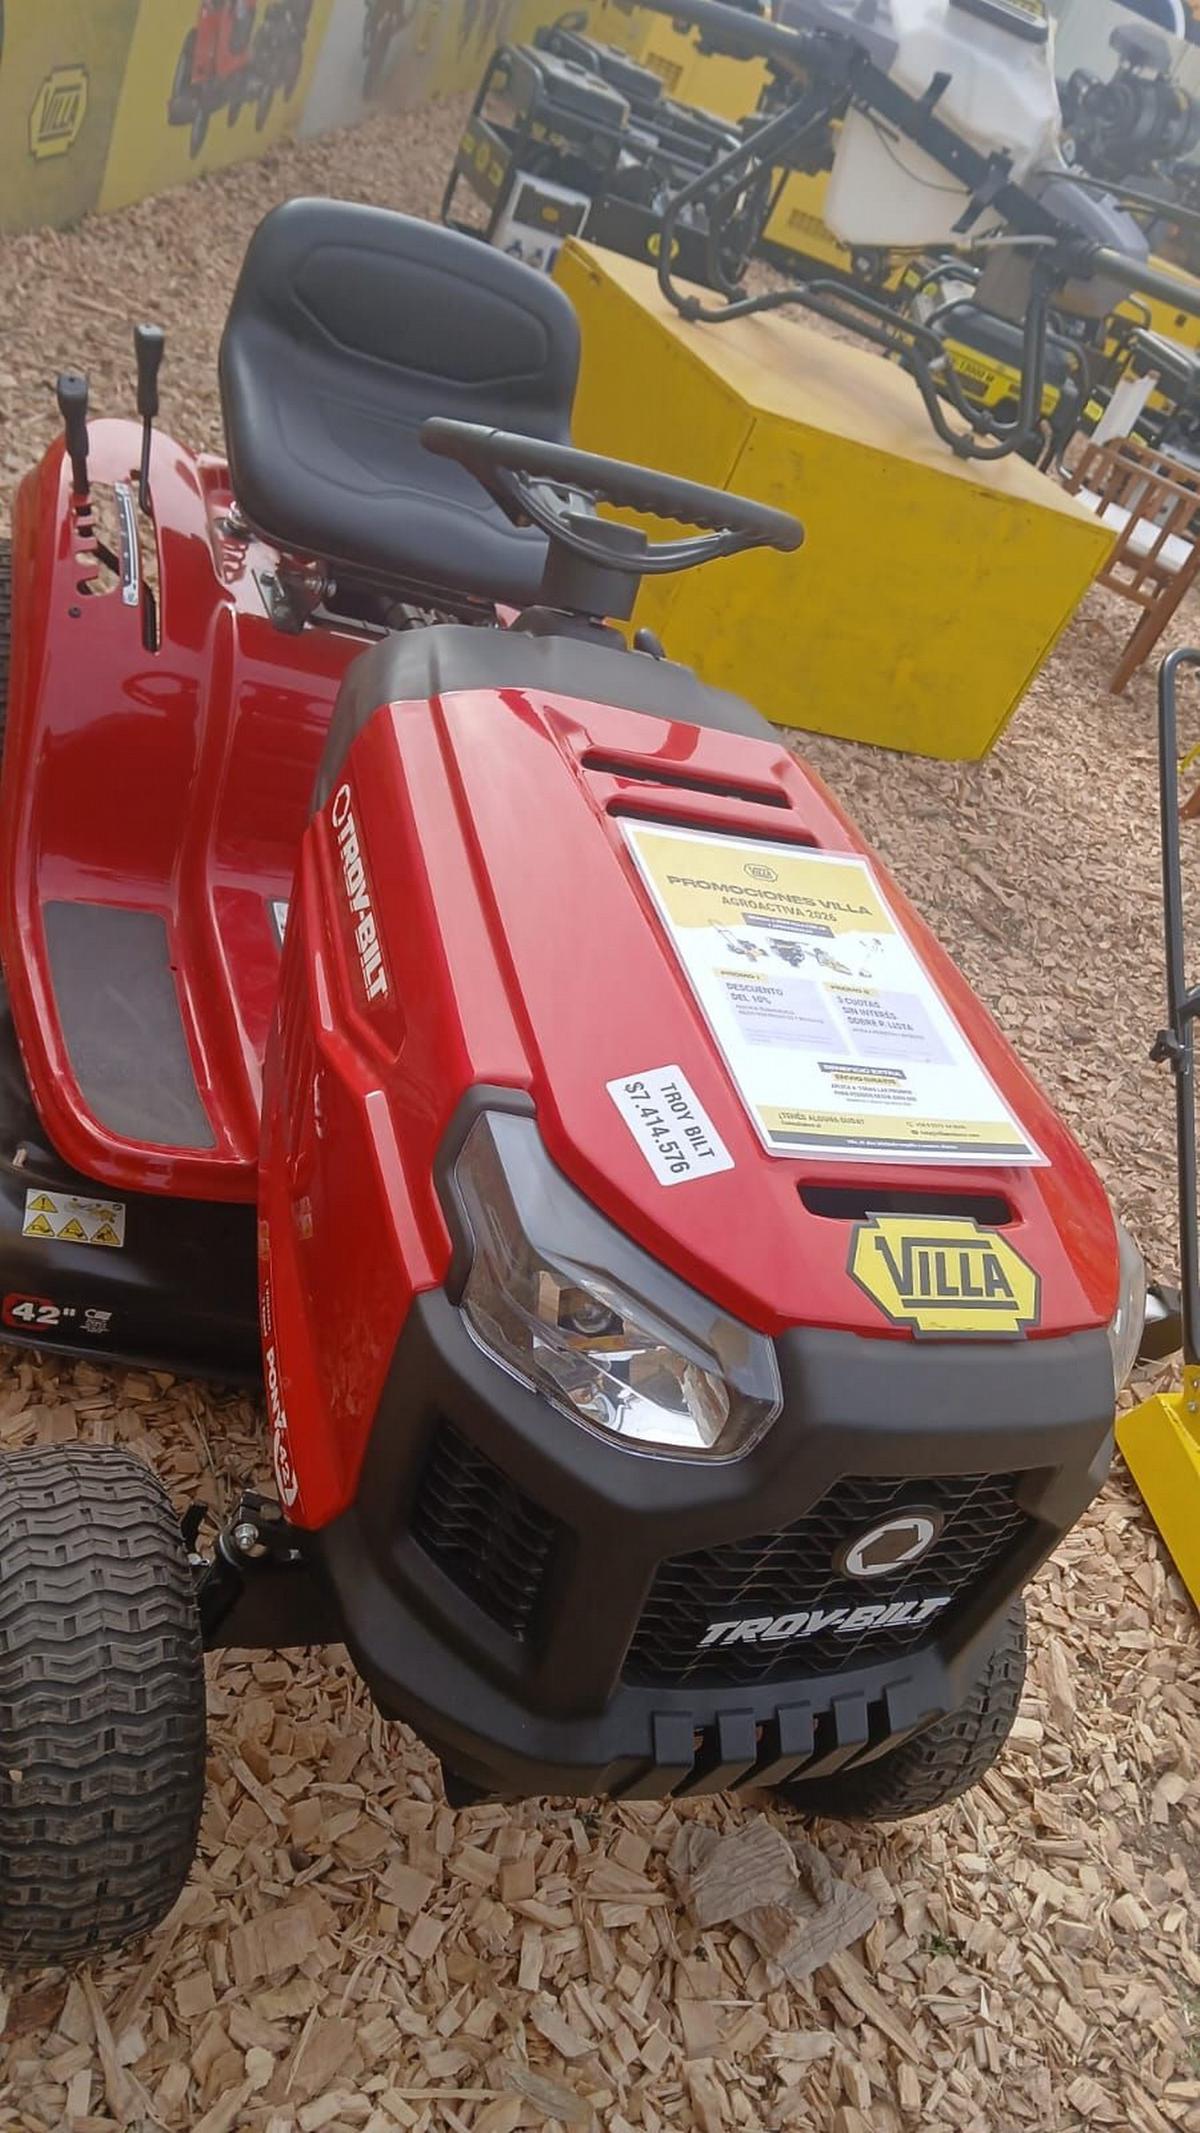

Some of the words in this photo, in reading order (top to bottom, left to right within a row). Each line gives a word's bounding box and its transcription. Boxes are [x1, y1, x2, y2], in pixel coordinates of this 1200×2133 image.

[338, 811, 390, 1003] TROY-BILT
[666, 875, 817, 907] PROMOCIONES
[818, 899, 873, 916] VILLA
[721, 896, 805, 917] AGROACTIVA
[805, 908, 838, 922] 2026
[726, 982, 784, 996] DESCUENTO
[731, 992, 750, 1002] DEL
[842, 1006, 858, 1015] SIN
[844, 997, 881, 1009] CUOTAS
[624, 1081, 691, 1174] $7.414.576
[660, 1082, 695, 1121] TROY
[684, 1126, 715, 1158] BILT
[874, 1235, 1015, 1298] VILLA
[266, 1345, 288, 1429] PONY
[696, 1596, 952, 1648] TROY-BILT
